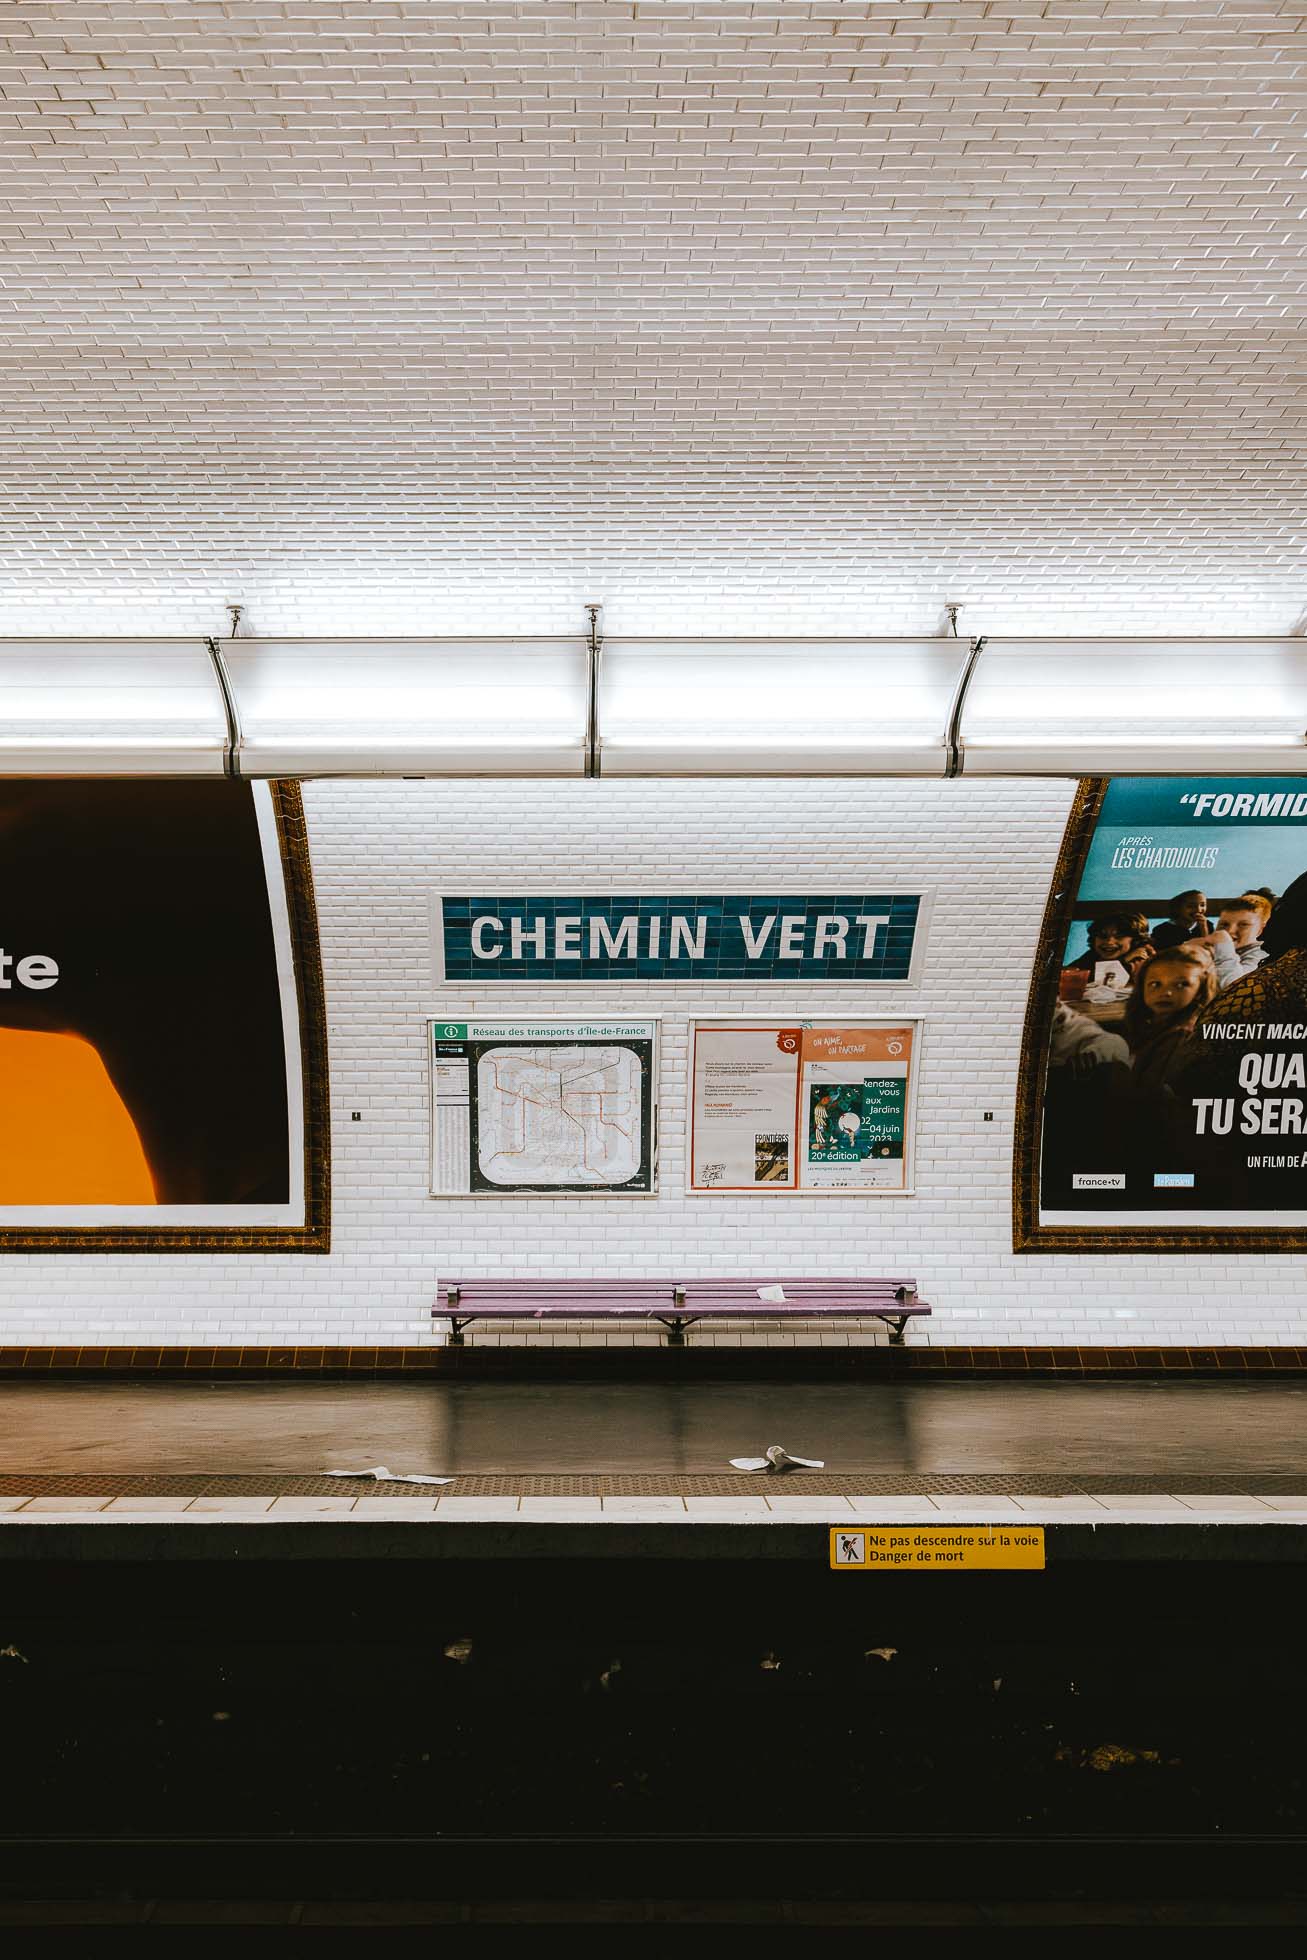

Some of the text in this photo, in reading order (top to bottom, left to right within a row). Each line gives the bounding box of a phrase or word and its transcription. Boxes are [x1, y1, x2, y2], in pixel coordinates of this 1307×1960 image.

[1118, 835, 1153, 846] APRÈS
[1111, 847, 1219, 869] LES CHATOUILLES
[470, 915, 889, 959] CHEMIN VERT
[472, 1028, 505, 1036] Réseau
[508, 1028, 526, 1036] des
[527, 1028, 574, 1037] transports
[1202, 1023, 1266, 1040] VINCENT
[1238, 1052, 1306, 1096] QUA
[865, 1097, 881, 1105] aux
[869, 1106, 900, 1115] Jardins
[1192, 1097, 1307, 1136] TU SER
[881, 1124, 900, 1135] juin
[827, 1151, 859, 1160] édition
[1247, 1155, 1260, 1168] UN
[1262, 1155, 1285, 1168] FILM
[1287, 1155, 1300, 1168] DE
[869, 1535, 1039, 1548] Ne pas descendre sur la voie
[870, 1550, 964, 1564] Danger de mort
